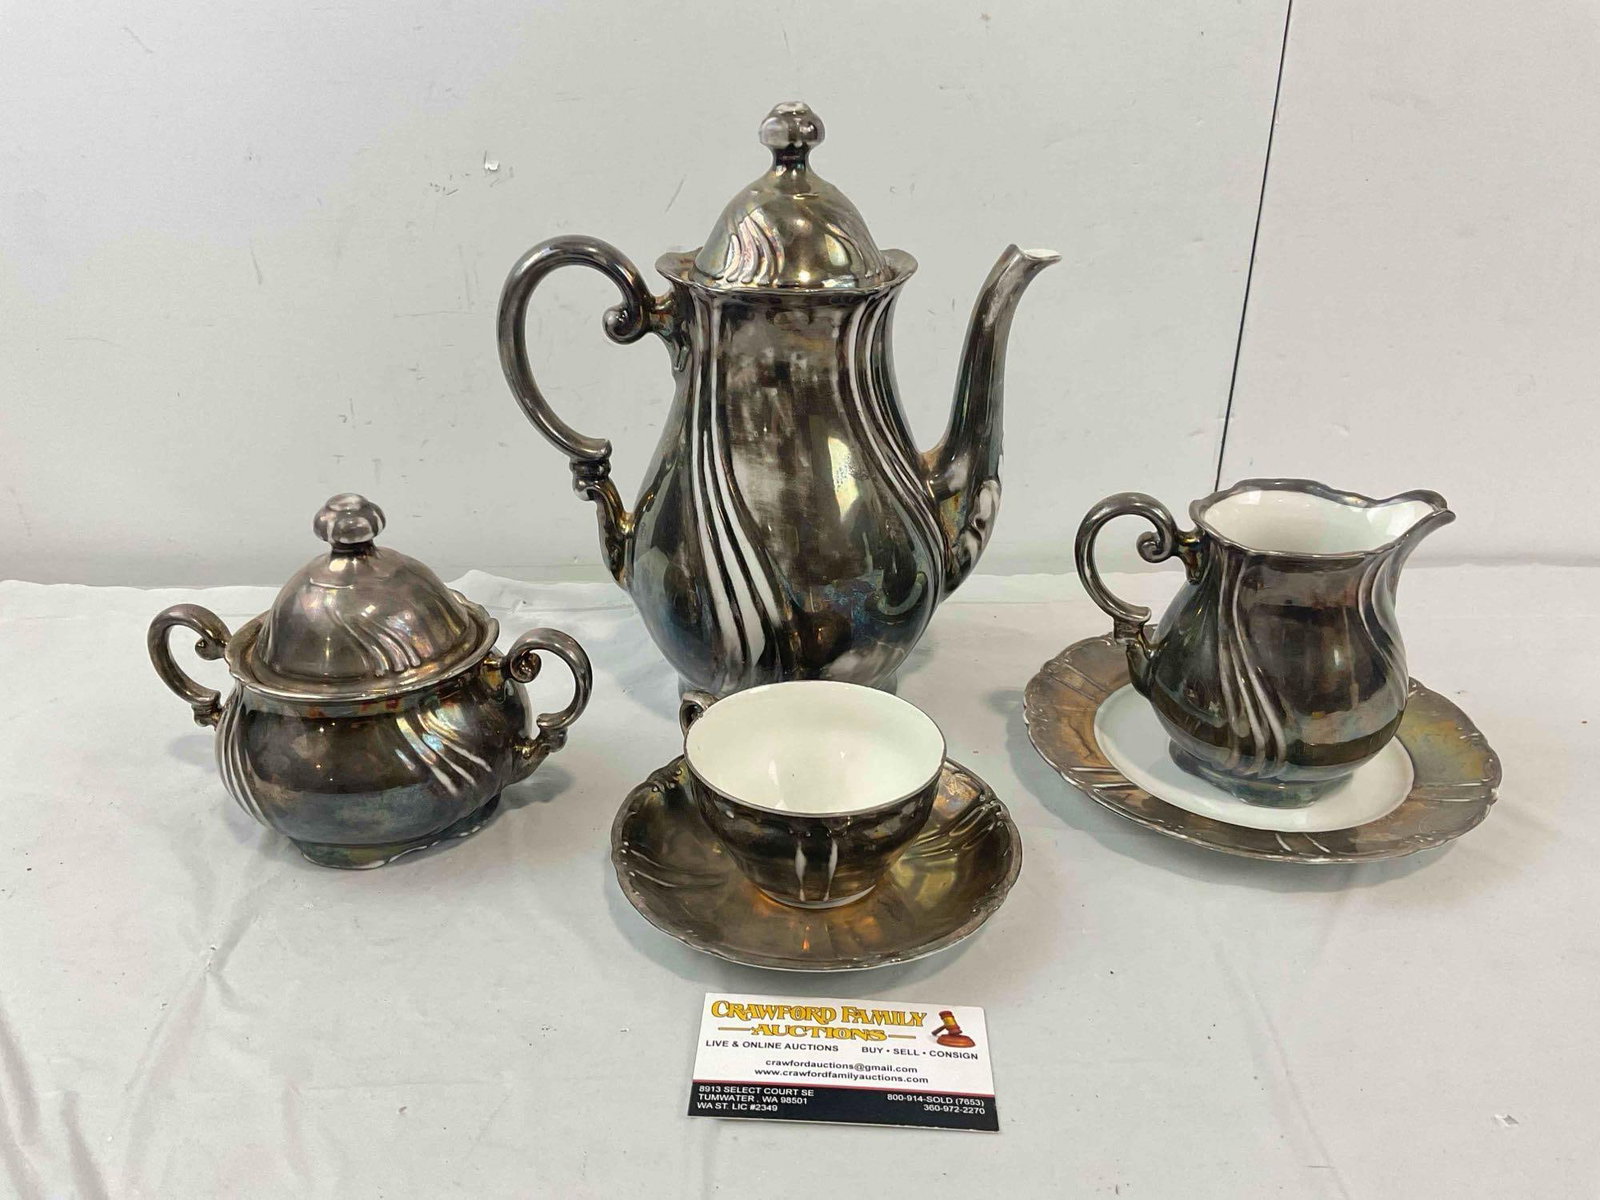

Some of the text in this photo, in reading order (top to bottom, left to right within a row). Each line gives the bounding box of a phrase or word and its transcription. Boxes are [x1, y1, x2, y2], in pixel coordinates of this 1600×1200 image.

[711, 1000, 927, 1027] CRAWFORD FAMILY
[751, 1023, 888, 1041] AUCTIONS
[705, 1040, 729, 1048] LIVE
[742, 1041, 781, 1050] ONLINE
[784, 1043, 839, 1052] AUCTIONS
[861, 1046, 979, 1060] BUY SELL CONSIGN
[765, 1059, 918, 1073] crawfordauctions@gmail.com
[754, 1068, 929, 1084] www.crawfordfamilyauctions.com
[699, 1085, 815, 1097] 8913 SELECT COURT SE
[698, 1093, 808, 1105] TUMWATER WA 98501
[886, 1093, 985, 1107] 800-914-SOLD (7653)
[697, 1101, 713, 1109] WA
[749, 1104, 778, 1112] #2349
[923, 1103, 986, 1115] 360-972-2270
